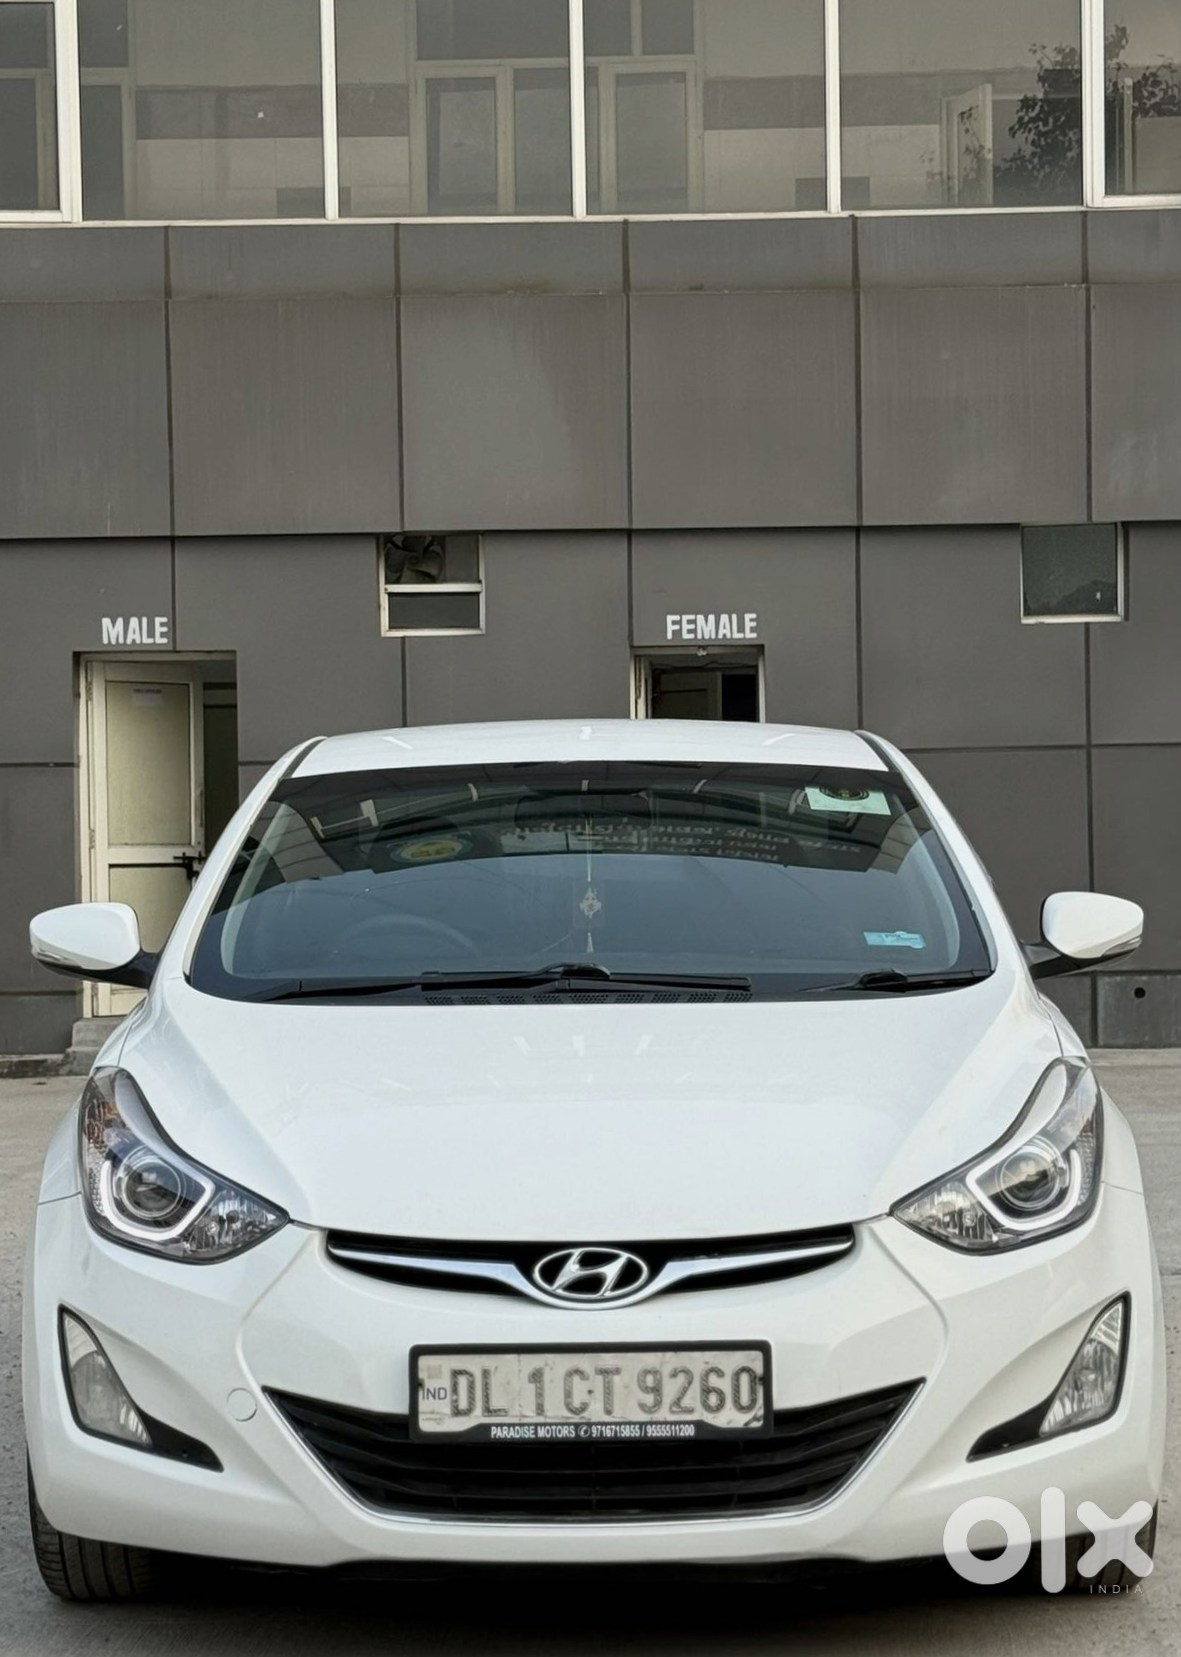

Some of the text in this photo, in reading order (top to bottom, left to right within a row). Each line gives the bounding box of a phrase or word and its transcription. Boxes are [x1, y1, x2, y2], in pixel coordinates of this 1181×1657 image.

[101, 616, 169, 645] MALE
[666, 613, 758, 640] FEMALE
[421, 1387, 447, 1400] IND
[450, 1367, 509, 1418] DL
[636, 1364, 760, 1416] 9260
[491, 1425, 535, 1438] PARADISE
[537, 1425, 576, 1438] MOTORS
[591, 1424, 640, 1438] 9716715855
[646, 1424, 695, 1437] 9555511200
